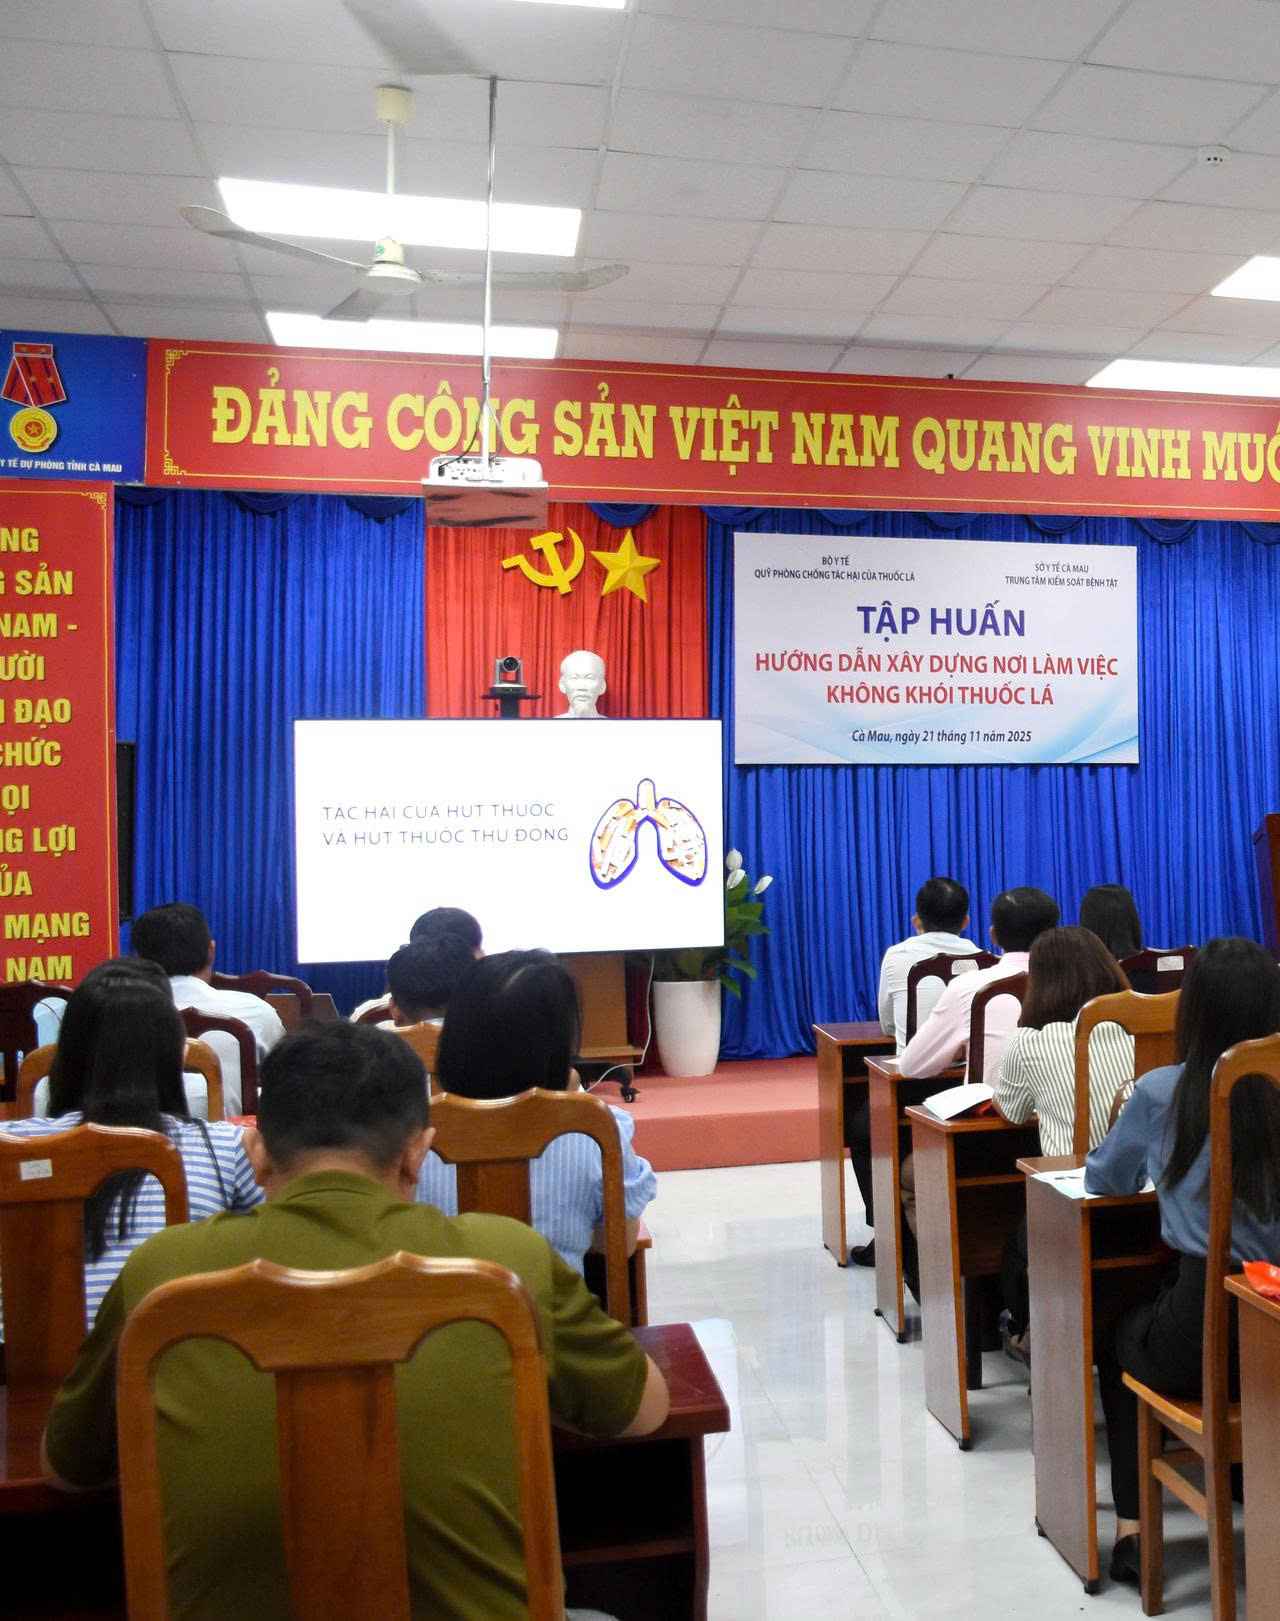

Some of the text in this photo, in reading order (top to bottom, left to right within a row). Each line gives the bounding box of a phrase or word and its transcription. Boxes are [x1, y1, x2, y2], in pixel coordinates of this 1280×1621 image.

[212, 367, 373, 449] ĐẢNG
[554, 383, 657, 459] SẢN
[670, 394, 779, 475] VIỆT
[791, 411, 900, 468] NAM
[912, 416, 1077, 475] QUANG
[1087, 423, 1191, 479] VINH
[8, 457, 19, 468] TẾ
[20, 460, 33, 470] DỰ
[34, 459, 65, 470] PHÒNG
[67, 459, 87, 472] TỈNH
[89, 462, 101, 472] CÀ
[103, 463, 122, 473] MAU
[754, 567, 915, 583] QUỸ PHÒNG CHỐNG TÁC HẠI CỦA THUỐC LÁ
[822, 555, 833, 567] BỘ
[840, 555, 850, 566] TẾ
[1035, 561, 1045, 572] SỞ
[1052, 561, 1061, 572] TẾ
[1061, 562, 1071, 573] CÀ
[1072, 564, 1089, 573] MAU
[15, 562, 73, 595] SẢN
[1005, 574, 1118, 590] TRUNG TÂM KIỂM SOÁT BỆNH TẬT
[856, 600, 1025, 643] TẬP HUẤN
[755, 646, 1118, 681] HƯỚNG DẪN XÂY DỰNG NƠI LÀM VIỆC
[826, 677, 1054, 706] KHÔNG KHÓI THUỐC LÁ
[14, 698, 71, 729] ĐẠO
[0, 736, 62, 767] HỨC
[852, 729, 1032, 746] Cà Mau, ngày 21 tháng 11 năm 2025
[33, 824, 76, 857] LỢI
[4, 911, 90, 944] MẠNG
[6, 955, 73, 982] NAM
